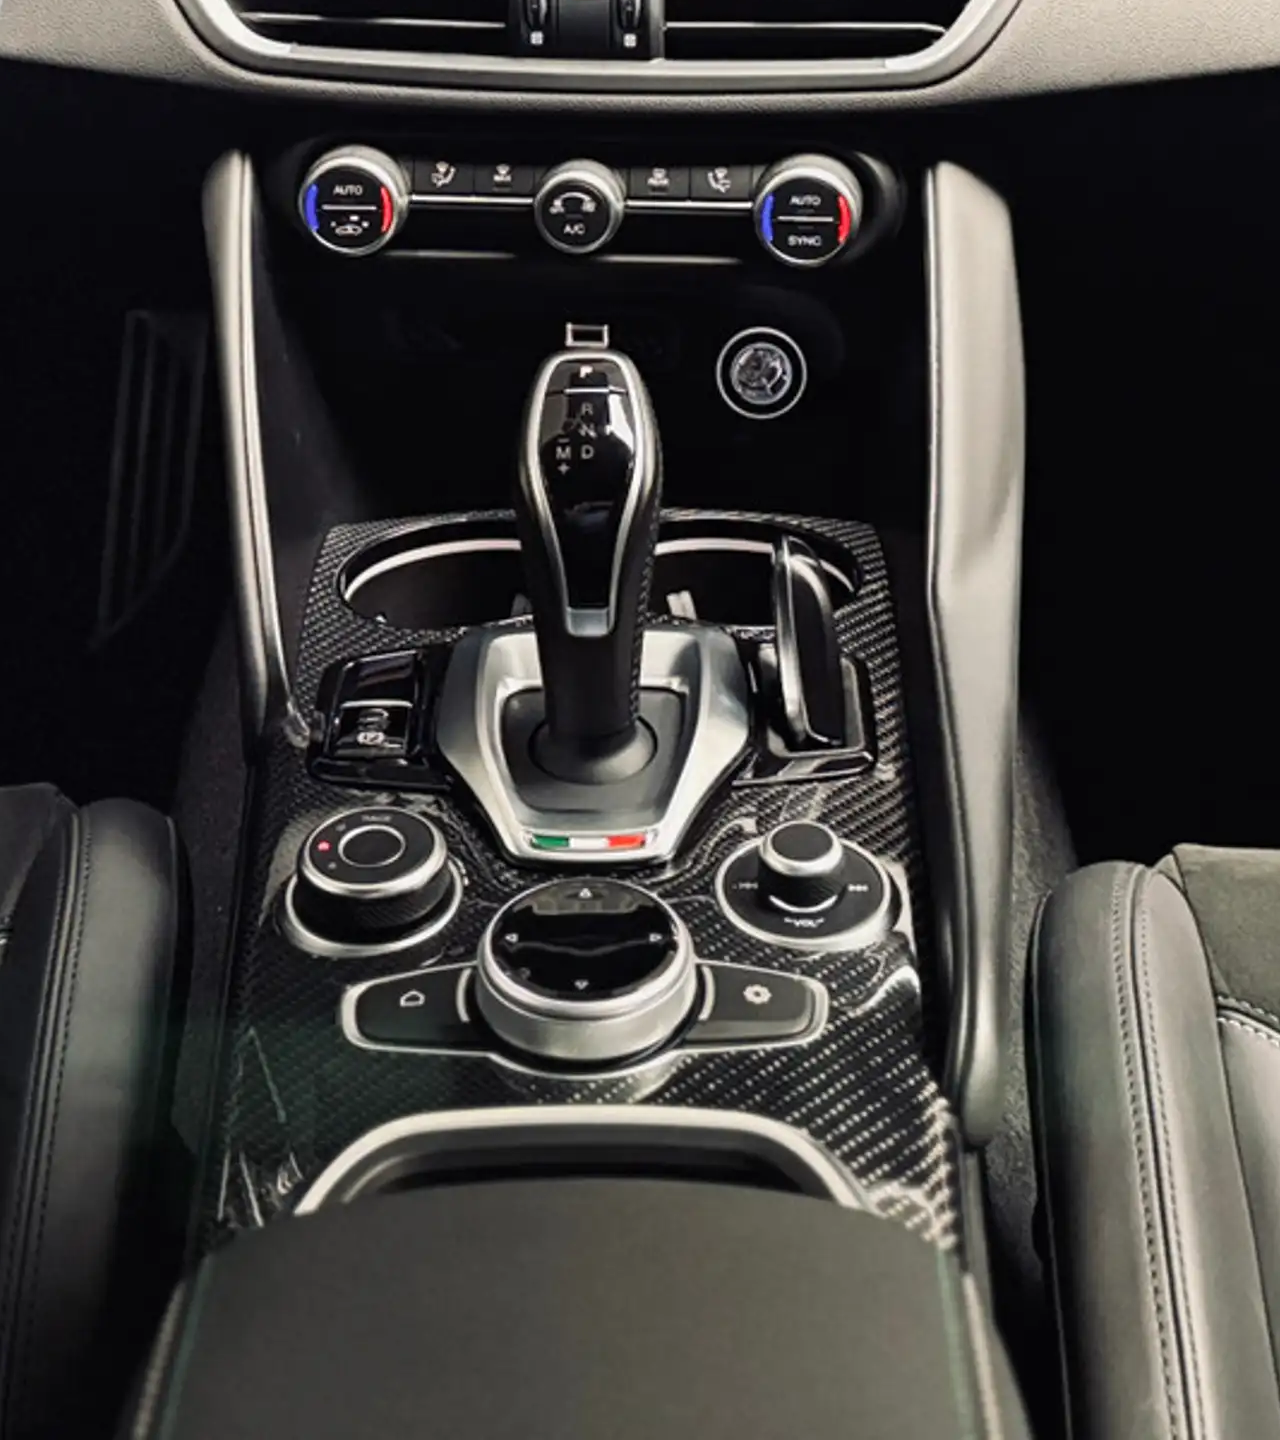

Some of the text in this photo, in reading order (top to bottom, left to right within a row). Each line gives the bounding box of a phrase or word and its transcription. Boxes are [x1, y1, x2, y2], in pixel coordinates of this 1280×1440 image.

[333, 184, 363, 197] AUTO
[789, 195, 821, 207] AUTO
[563, 223, 586, 236] A/C
[787, 234, 822, 247] SYNC
[580, 366, 593, 378] P
[581, 403, 593, 415] R
[556, 445, 594, 460] M D
